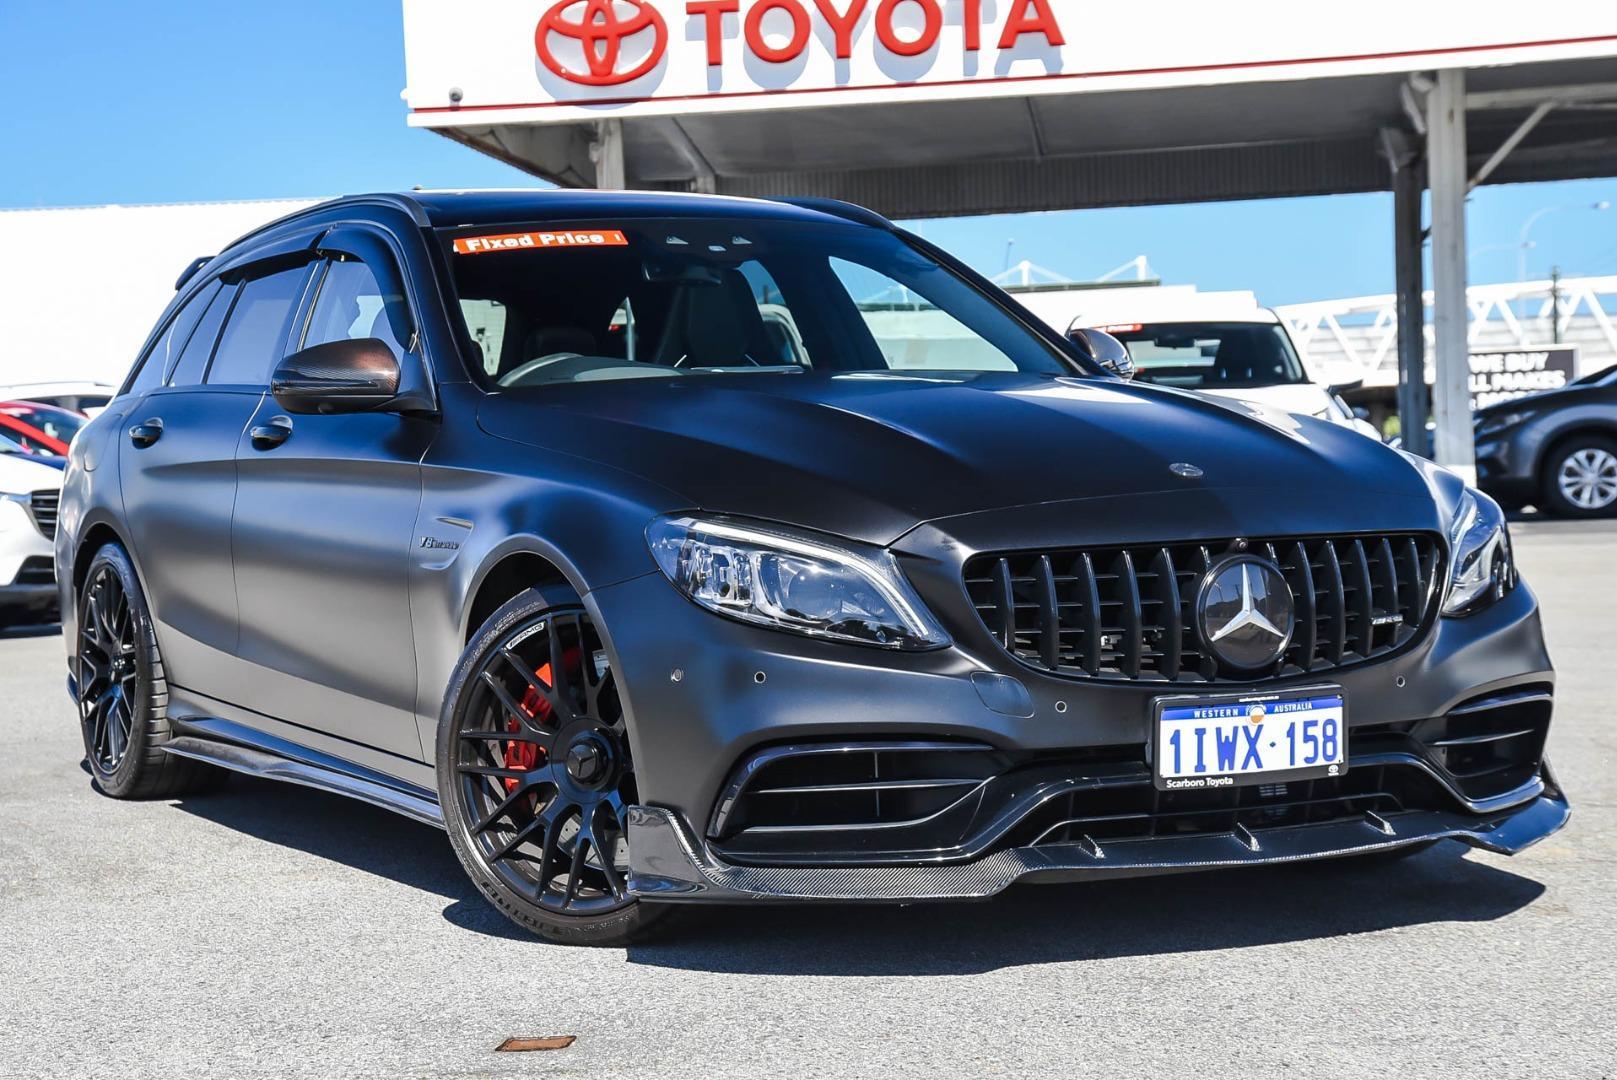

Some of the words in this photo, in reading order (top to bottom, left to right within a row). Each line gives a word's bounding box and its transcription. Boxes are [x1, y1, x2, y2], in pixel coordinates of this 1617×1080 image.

[466, 234, 535, 251] Fixed
[539, 232, 605, 245] Price
[1468, 354, 1504, 373] WE
[1468, 373, 1491, 393] LL
[1194, 708, 1239, 719] WESTERN
[1274, 702, 1313, 713] AUSTRALIA
[1166, 778, 1205, 789] Scarboro
[1206, 776, 1234, 788] Toyota
